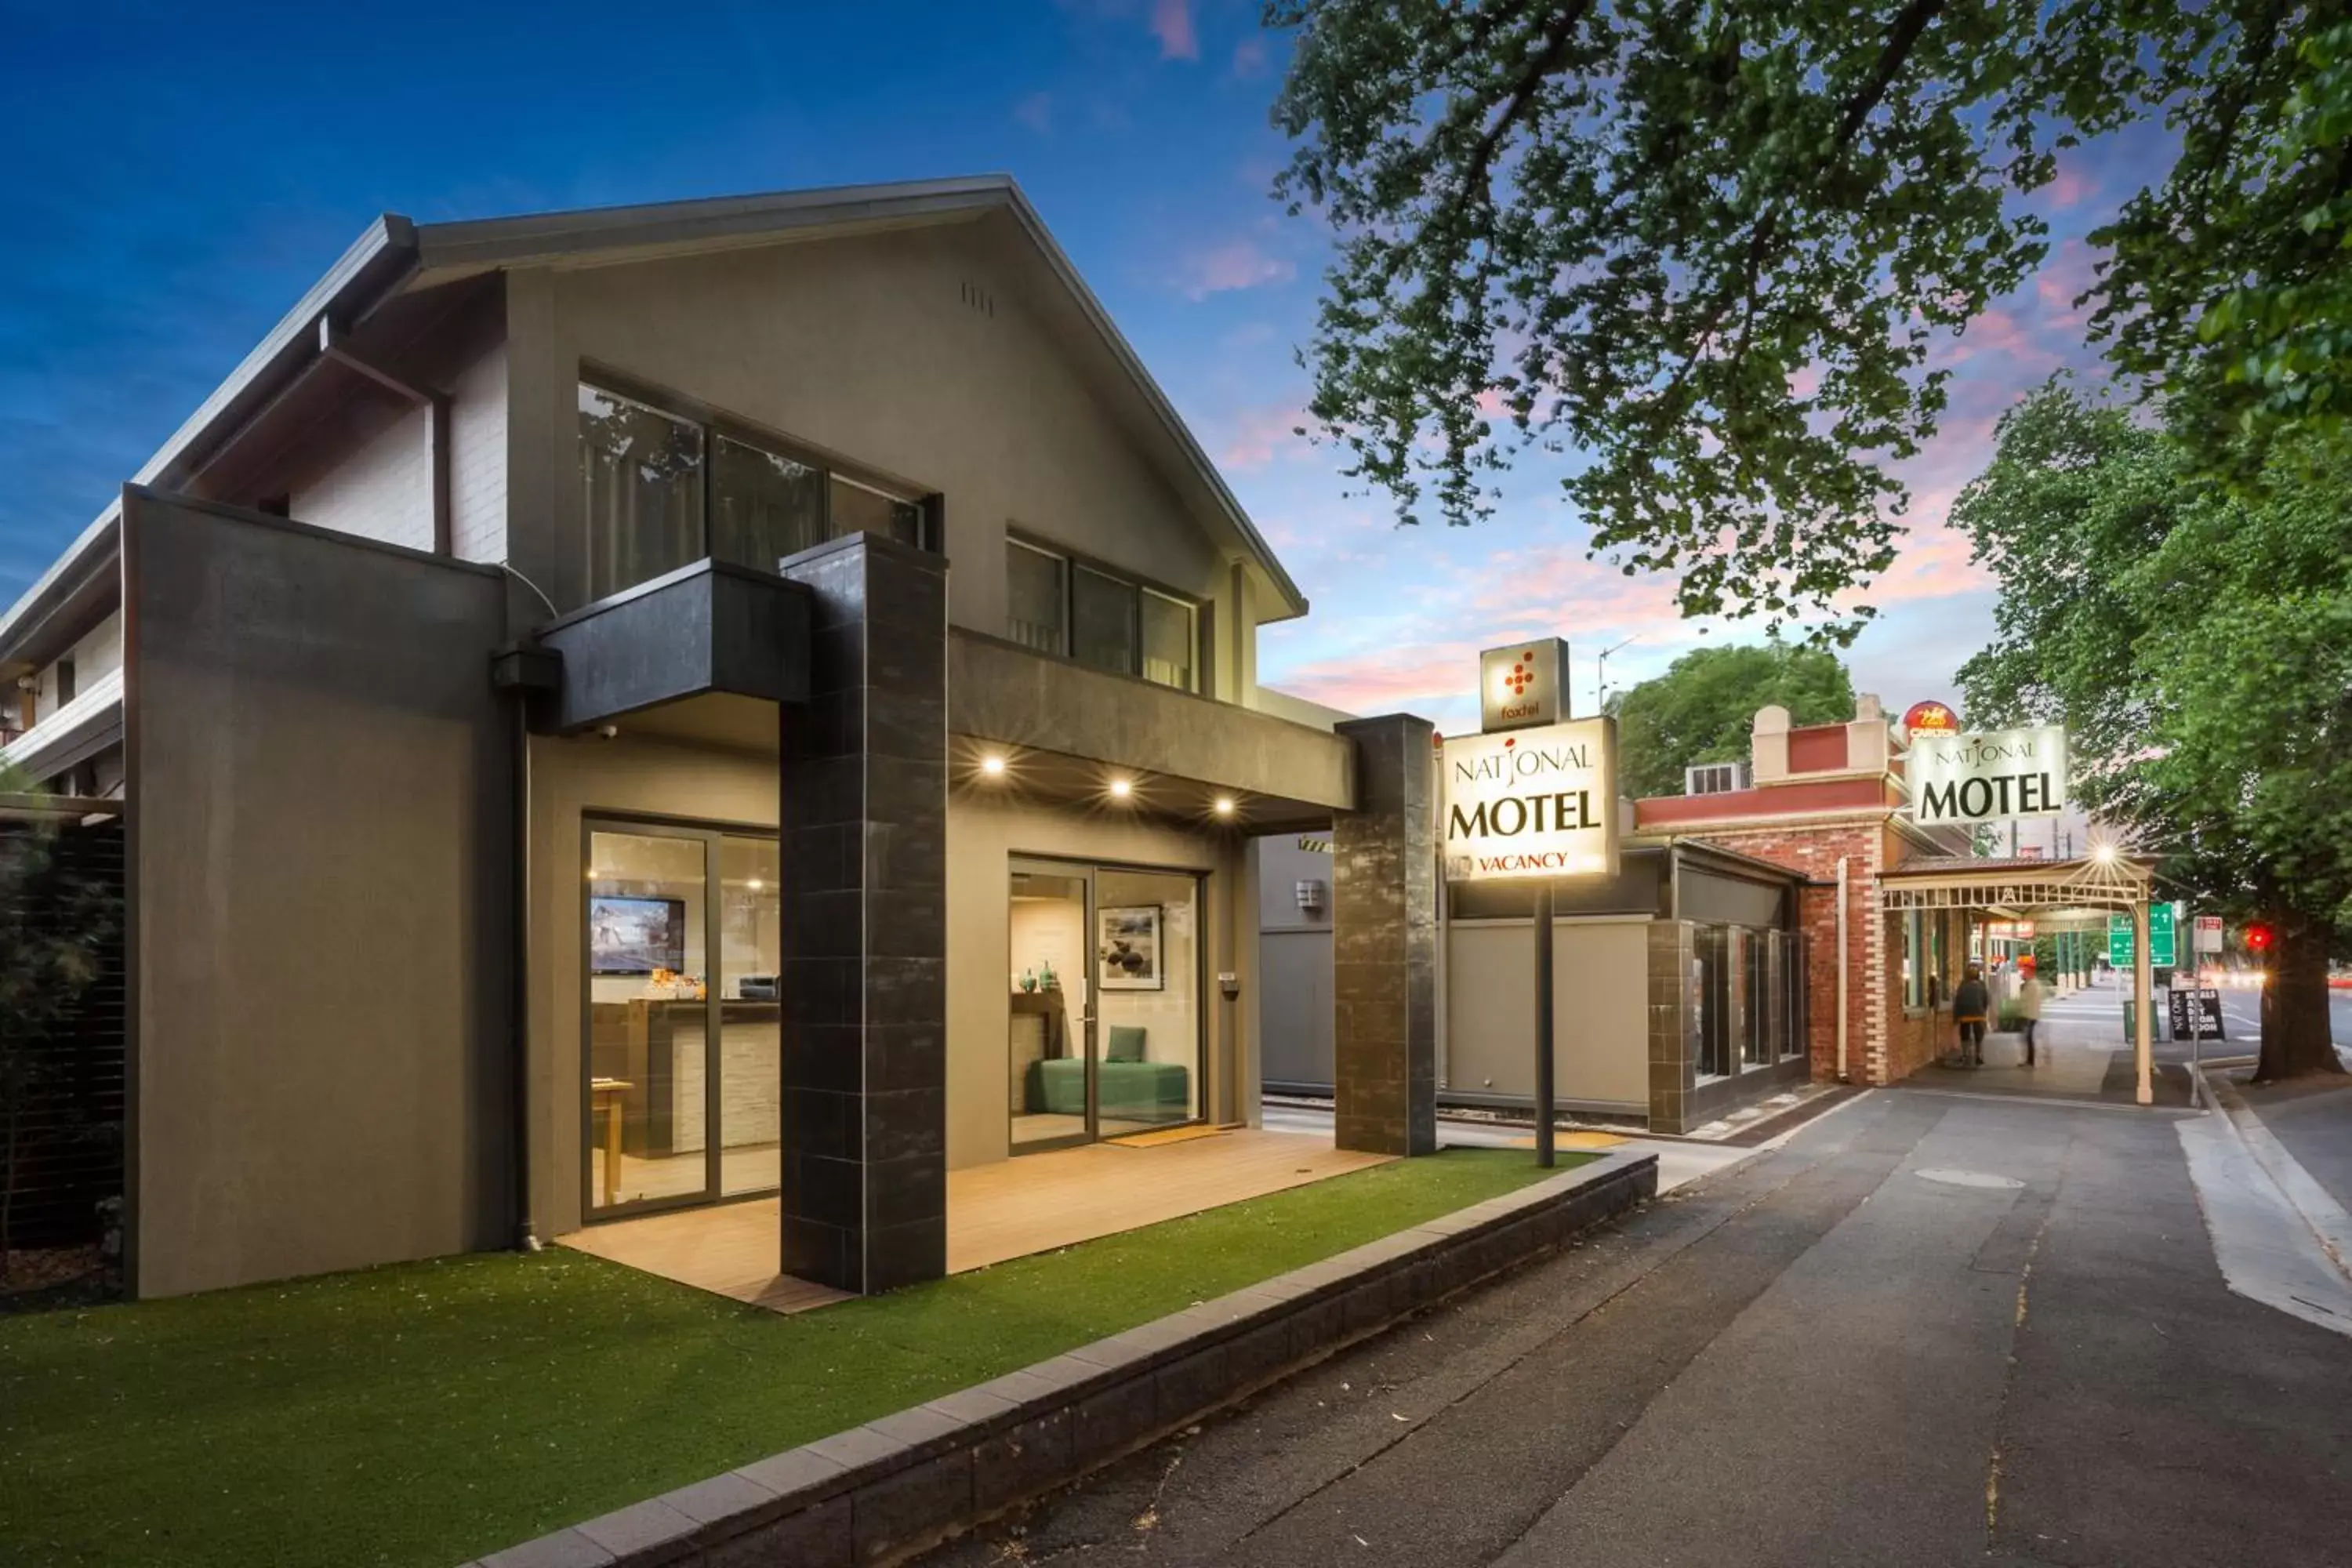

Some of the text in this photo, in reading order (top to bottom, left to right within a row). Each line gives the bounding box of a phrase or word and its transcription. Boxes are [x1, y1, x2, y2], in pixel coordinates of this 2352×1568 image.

[1455, 738, 1594, 788] NATIONAL
[1448, 789, 1602, 840] MOTEL
[1921, 772, 2061, 819] MOTEL
[1479, 851, 1568, 872] VACANCY
[2185, 990, 2216, 1000] MALS
